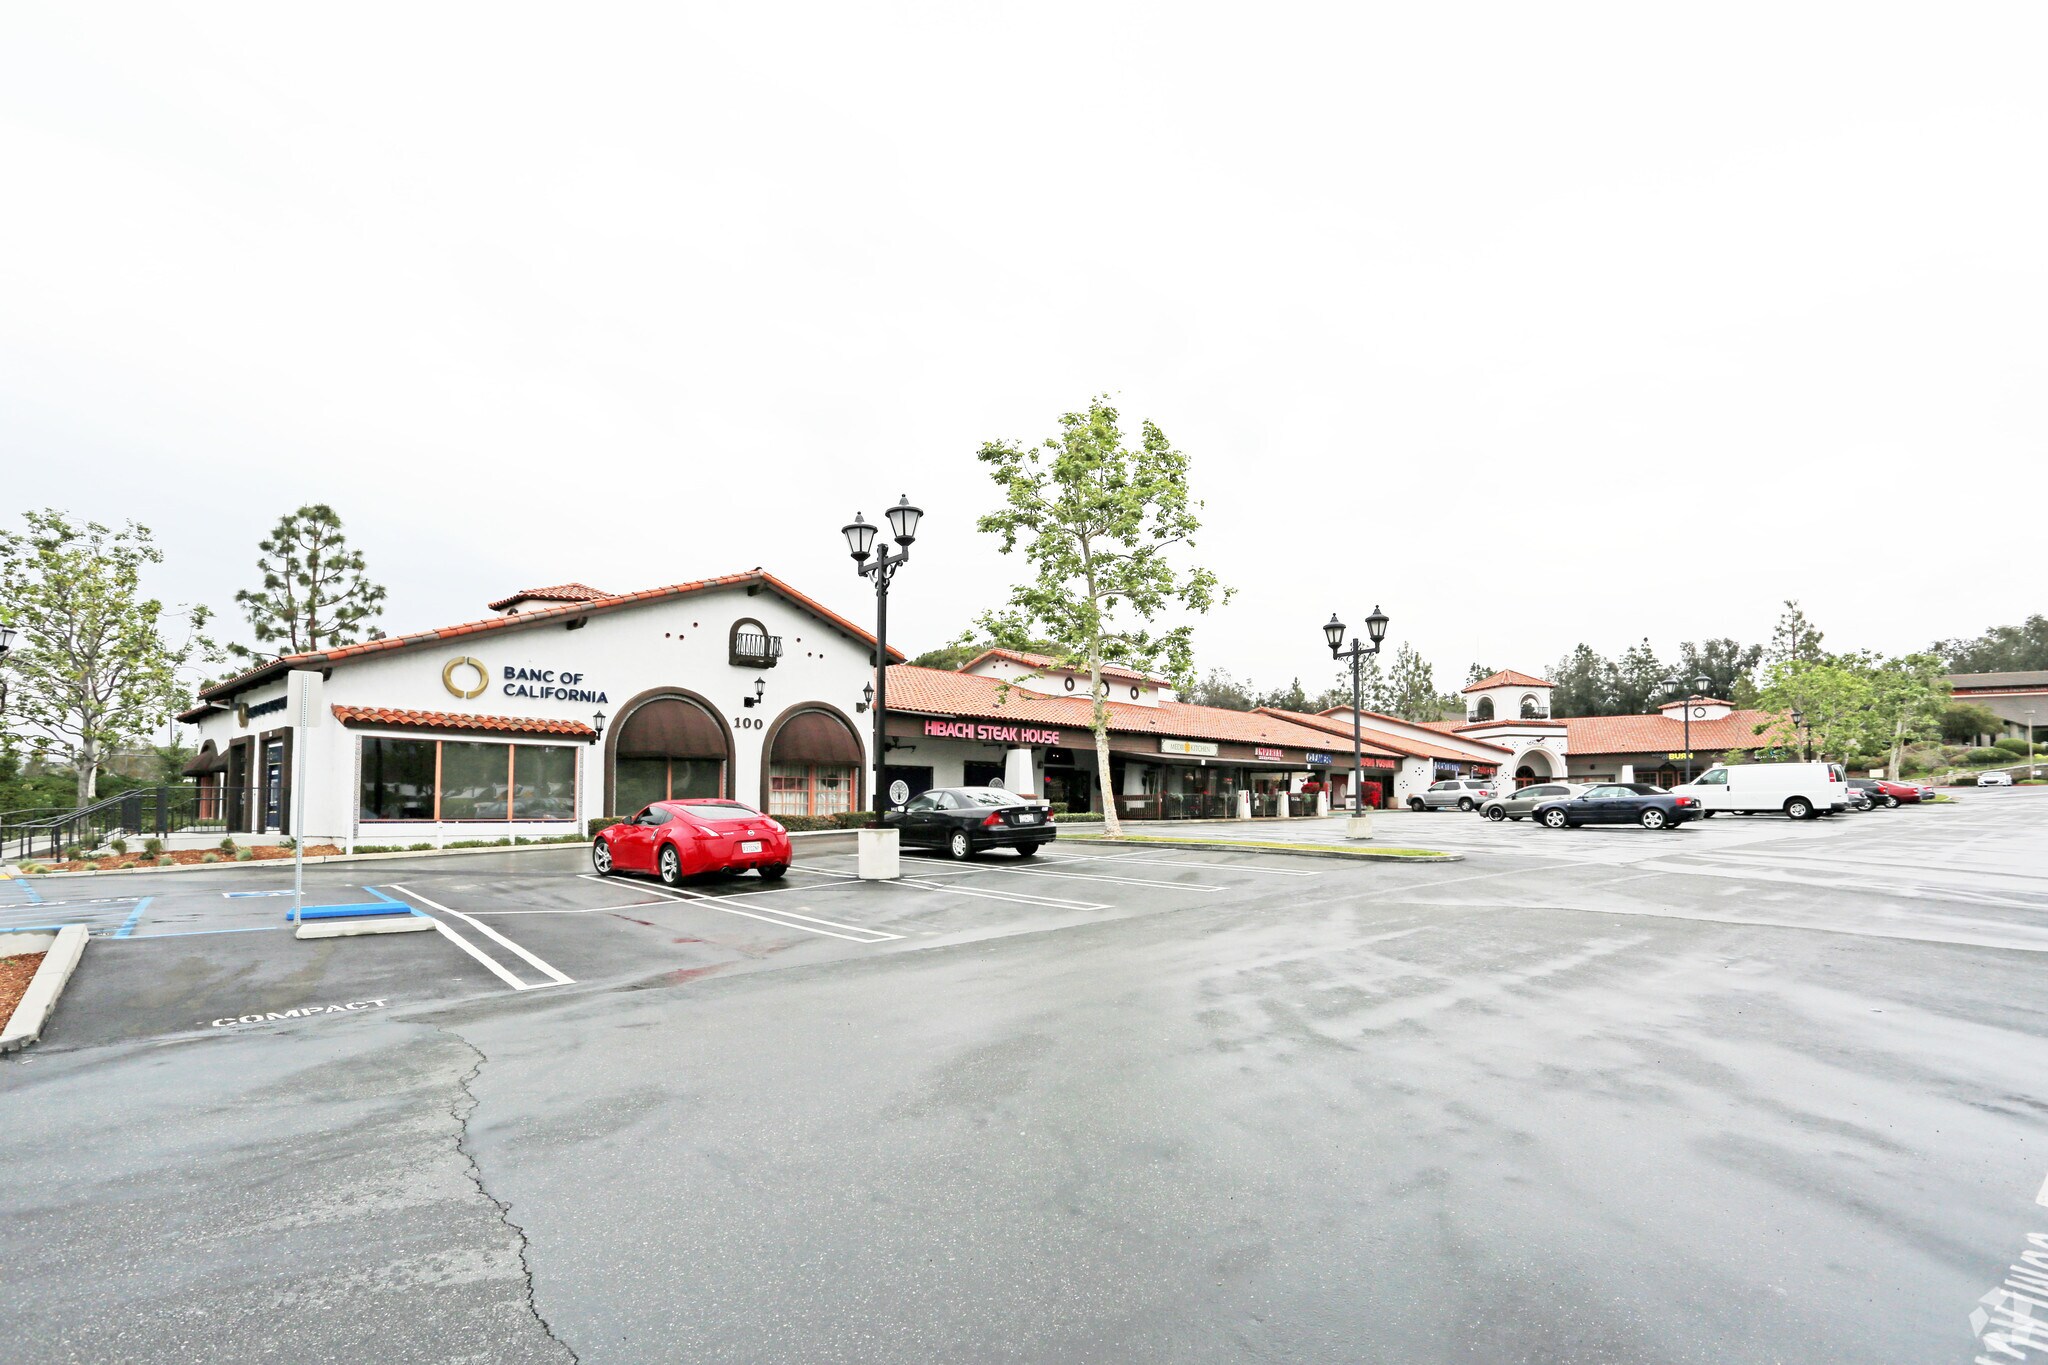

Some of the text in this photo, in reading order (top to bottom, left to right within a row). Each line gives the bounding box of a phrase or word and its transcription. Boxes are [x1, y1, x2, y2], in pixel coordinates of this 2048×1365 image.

[503, 666, 584, 685] BANC OF
[503, 683, 609, 704] CALIFORNIA
[734, 717, 763, 730] 100
[924, 720, 1060, 745] HIBACHI STEAK HOUSE
[211, 998, 388, 1028] COMPACT
